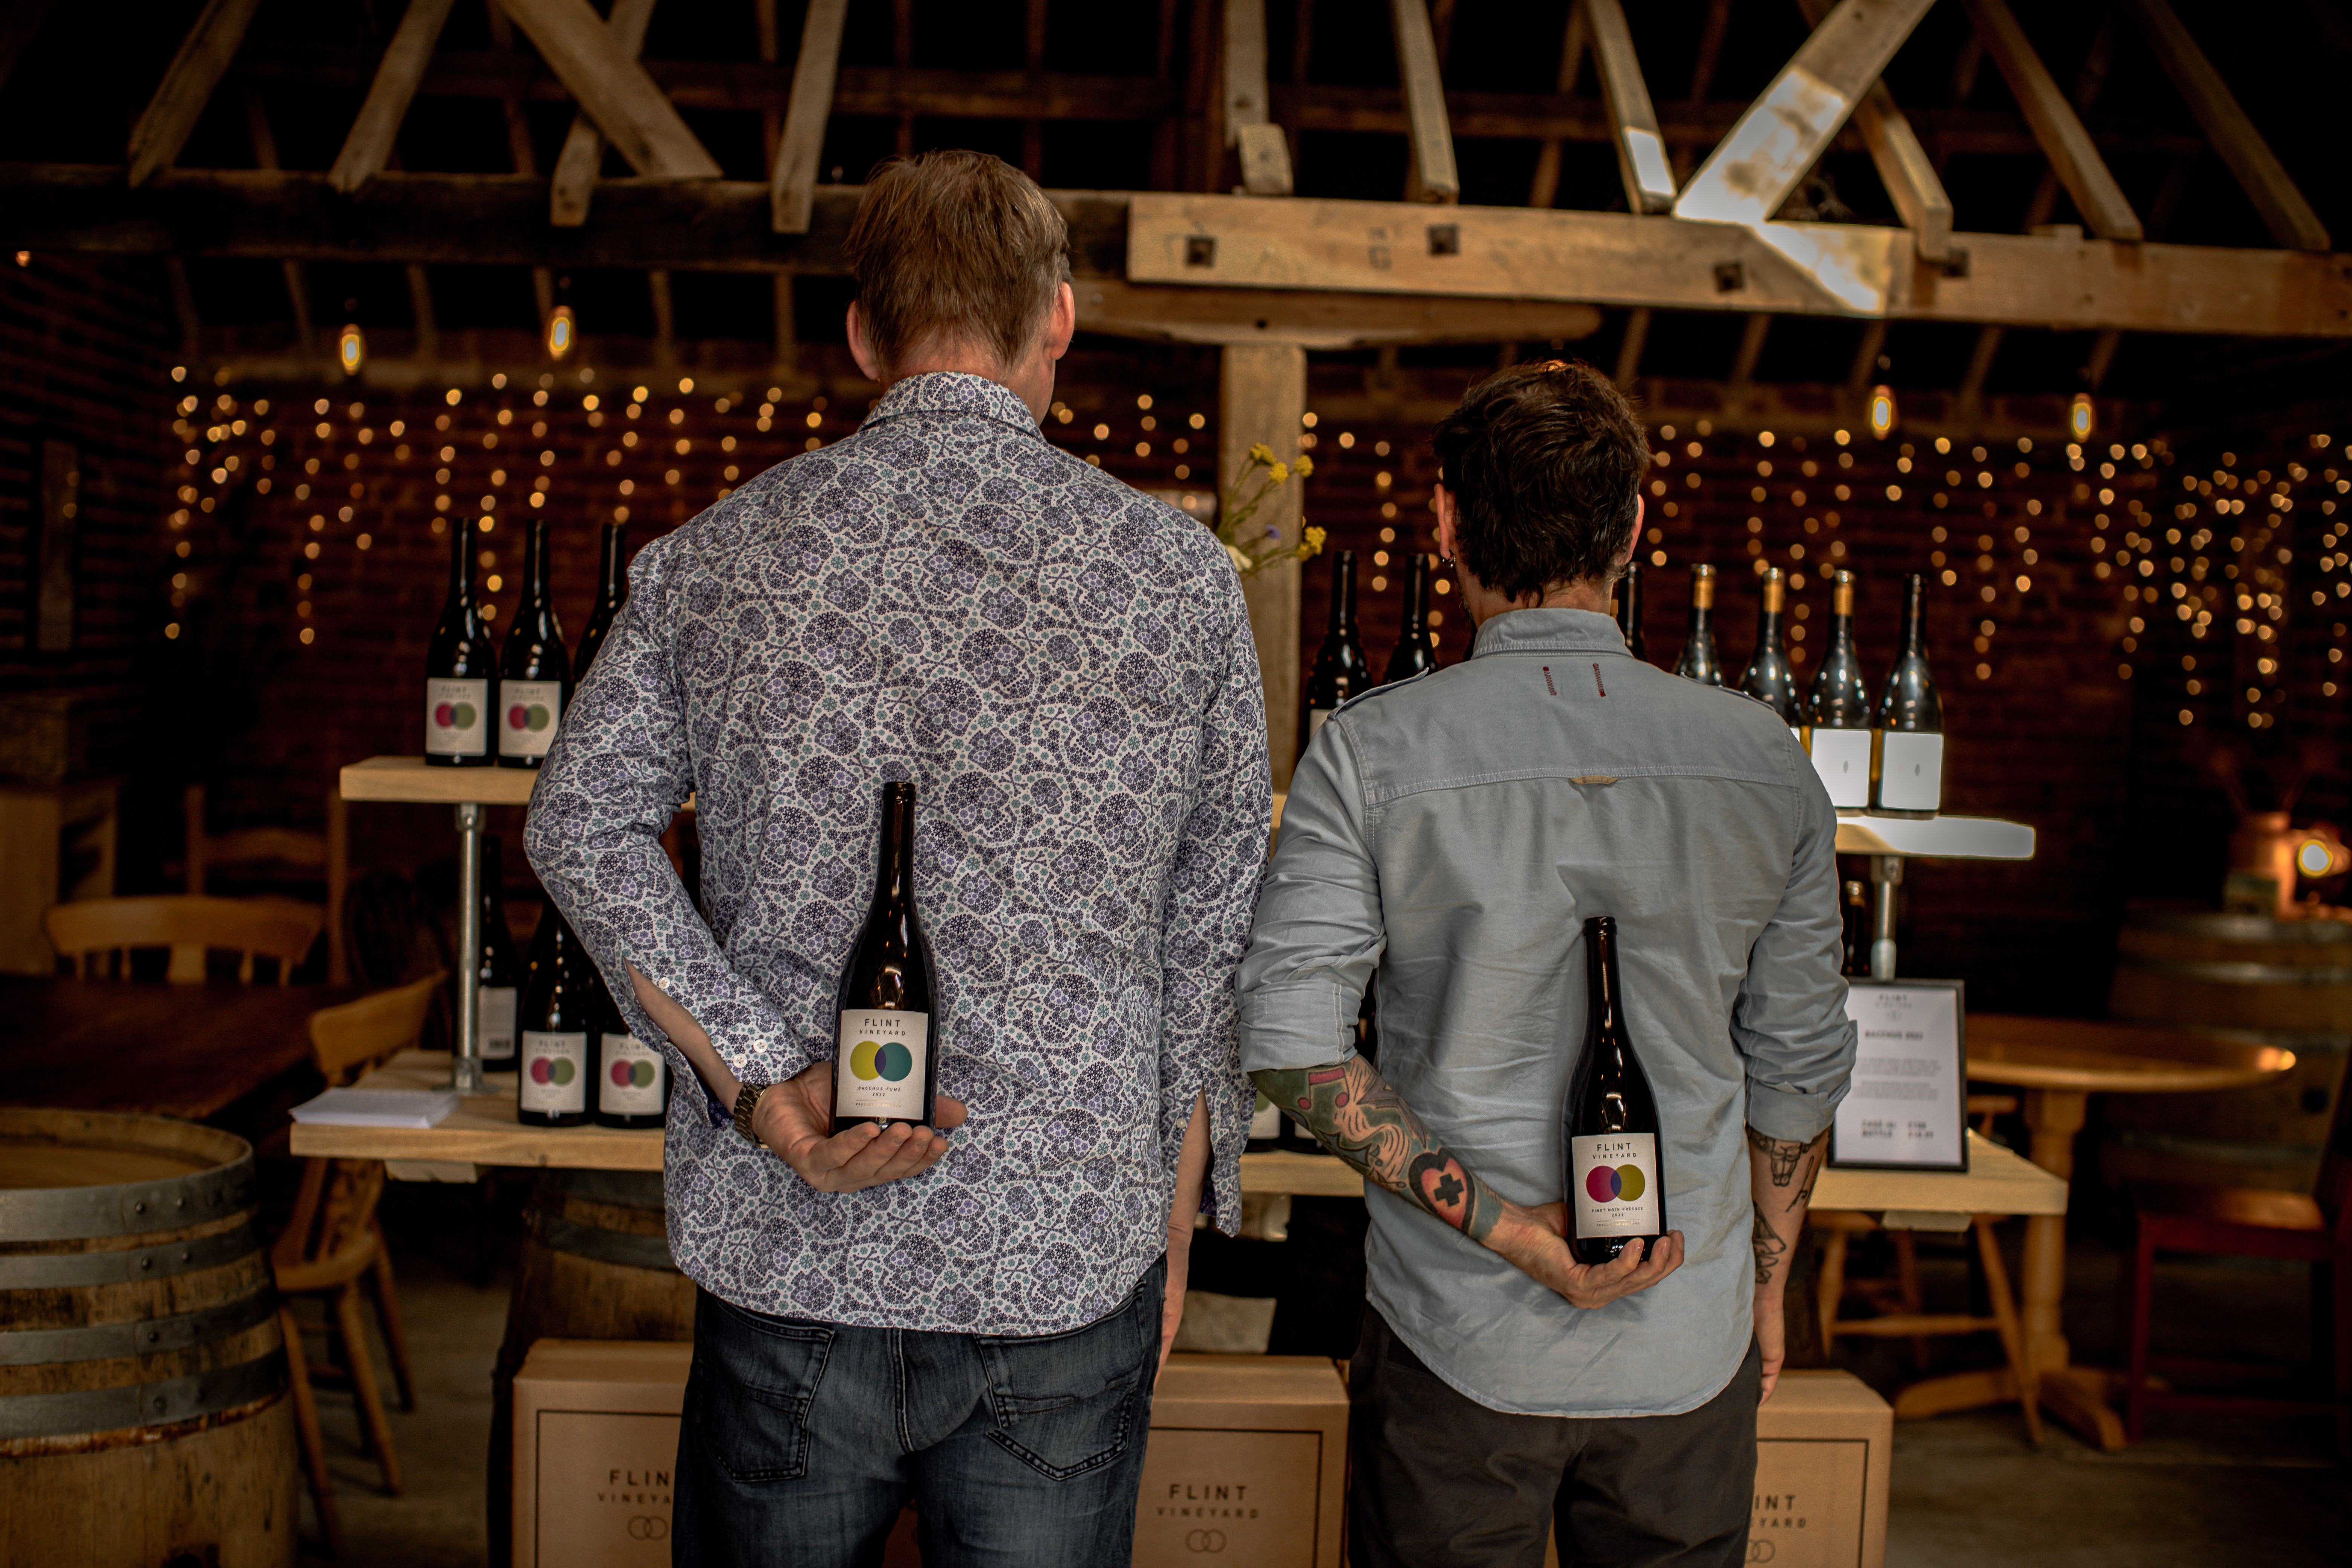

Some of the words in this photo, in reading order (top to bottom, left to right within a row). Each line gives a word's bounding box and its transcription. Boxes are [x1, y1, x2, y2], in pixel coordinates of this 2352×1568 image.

[865, 1018, 900, 1027] FLINT
[1597, 1142, 1631, 1151] FLINT
[610, 1470, 669, 1486] FLIN
[1170, 1484, 1246, 1500] FLINT
[598, 1493, 671, 1504] VINEYA
[1755, 1494, 1796, 1510] INT
[1157, 1507, 1259, 1519] VINEYARD
